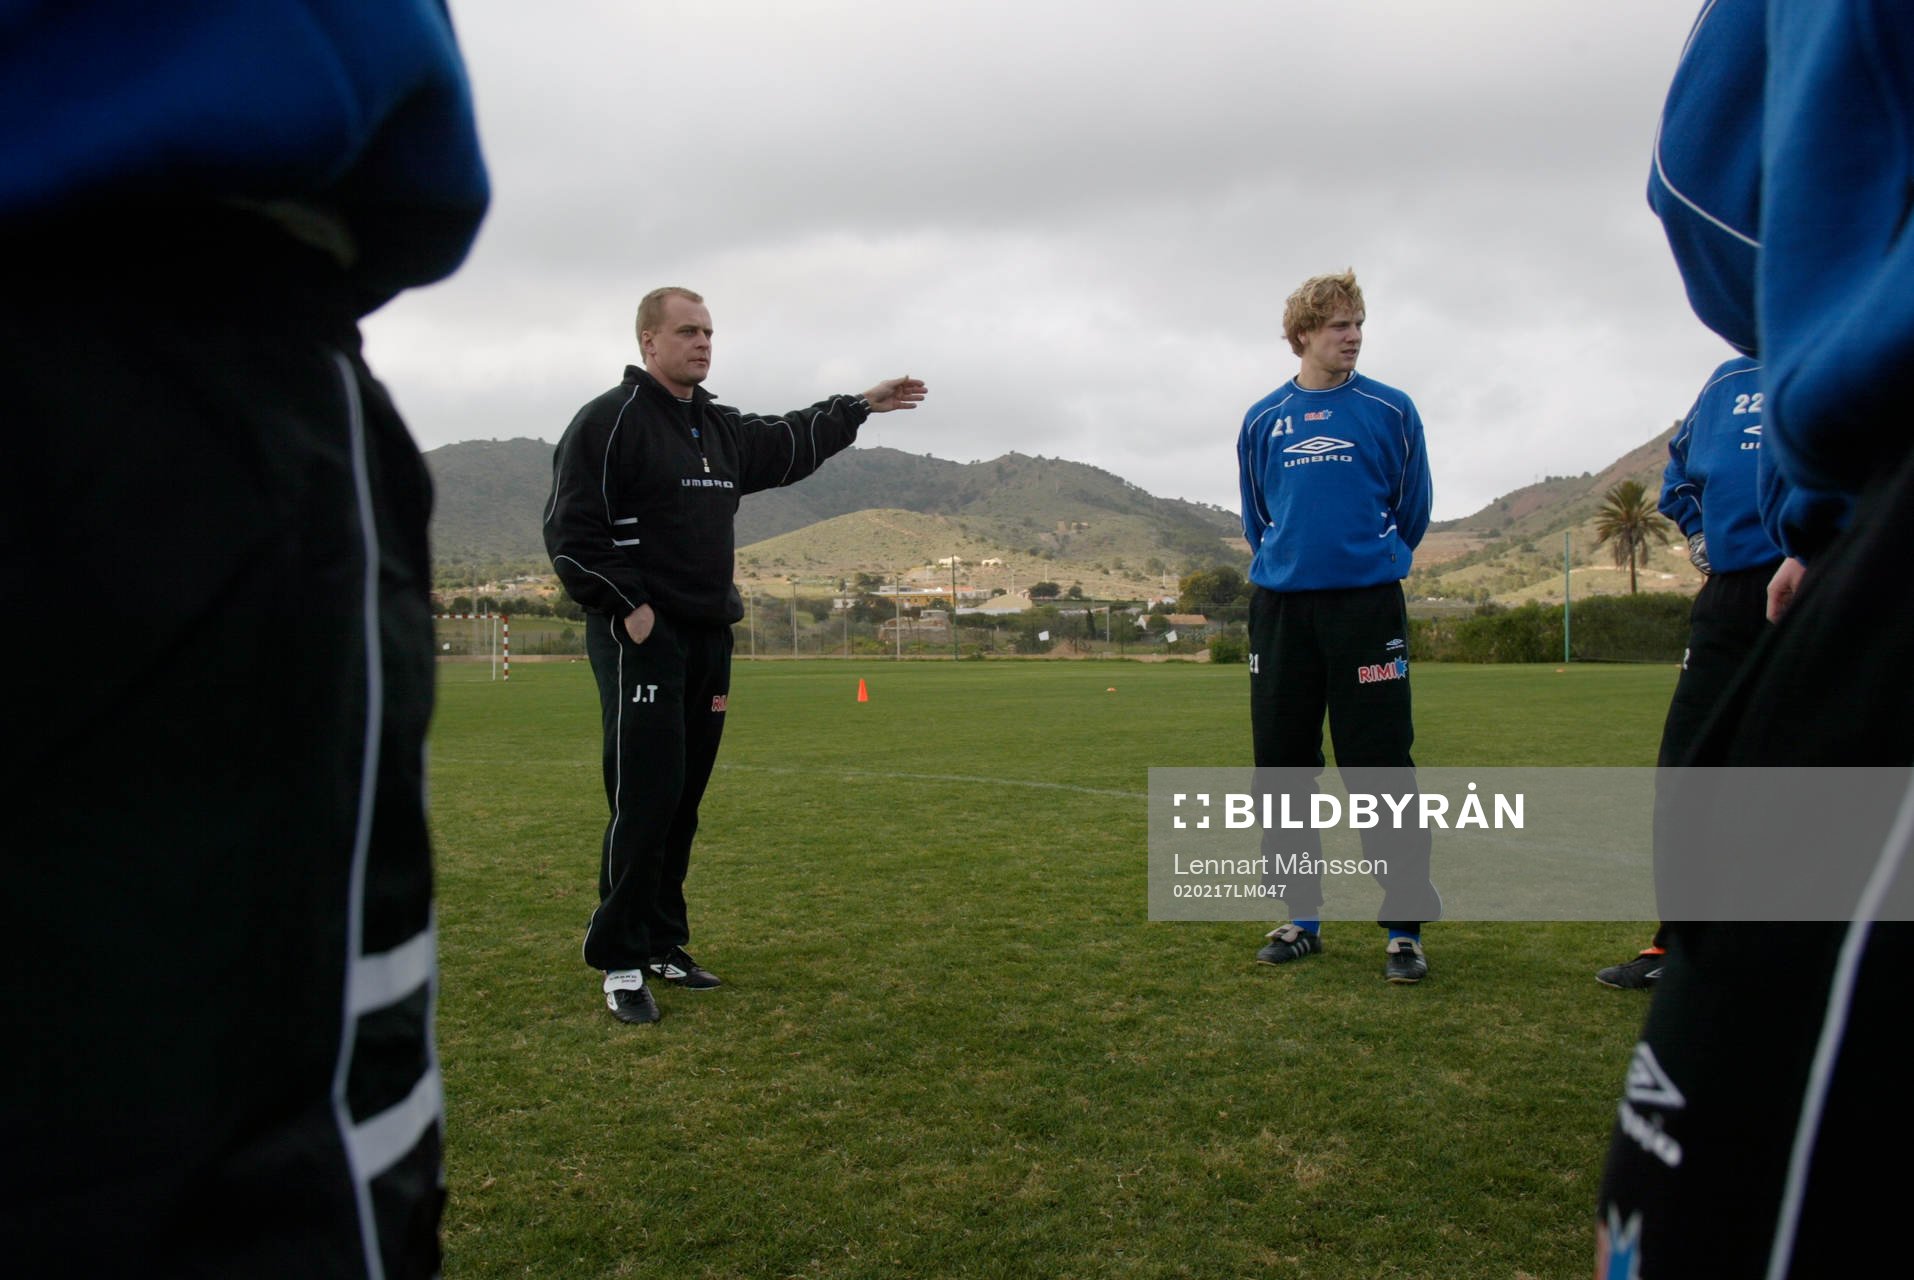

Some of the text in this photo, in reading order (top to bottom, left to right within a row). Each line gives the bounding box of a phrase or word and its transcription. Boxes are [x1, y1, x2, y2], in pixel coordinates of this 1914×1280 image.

[1733, 392, 1763, 415] 22
[1271, 416, 1294, 437] 21
[1284, 454, 1353, 468] UMBRO
[681, 478, 733, 489] UMBRO
[1358, 662, 1397, 684] RIMI
[632, 684, 658, 703] J.T
